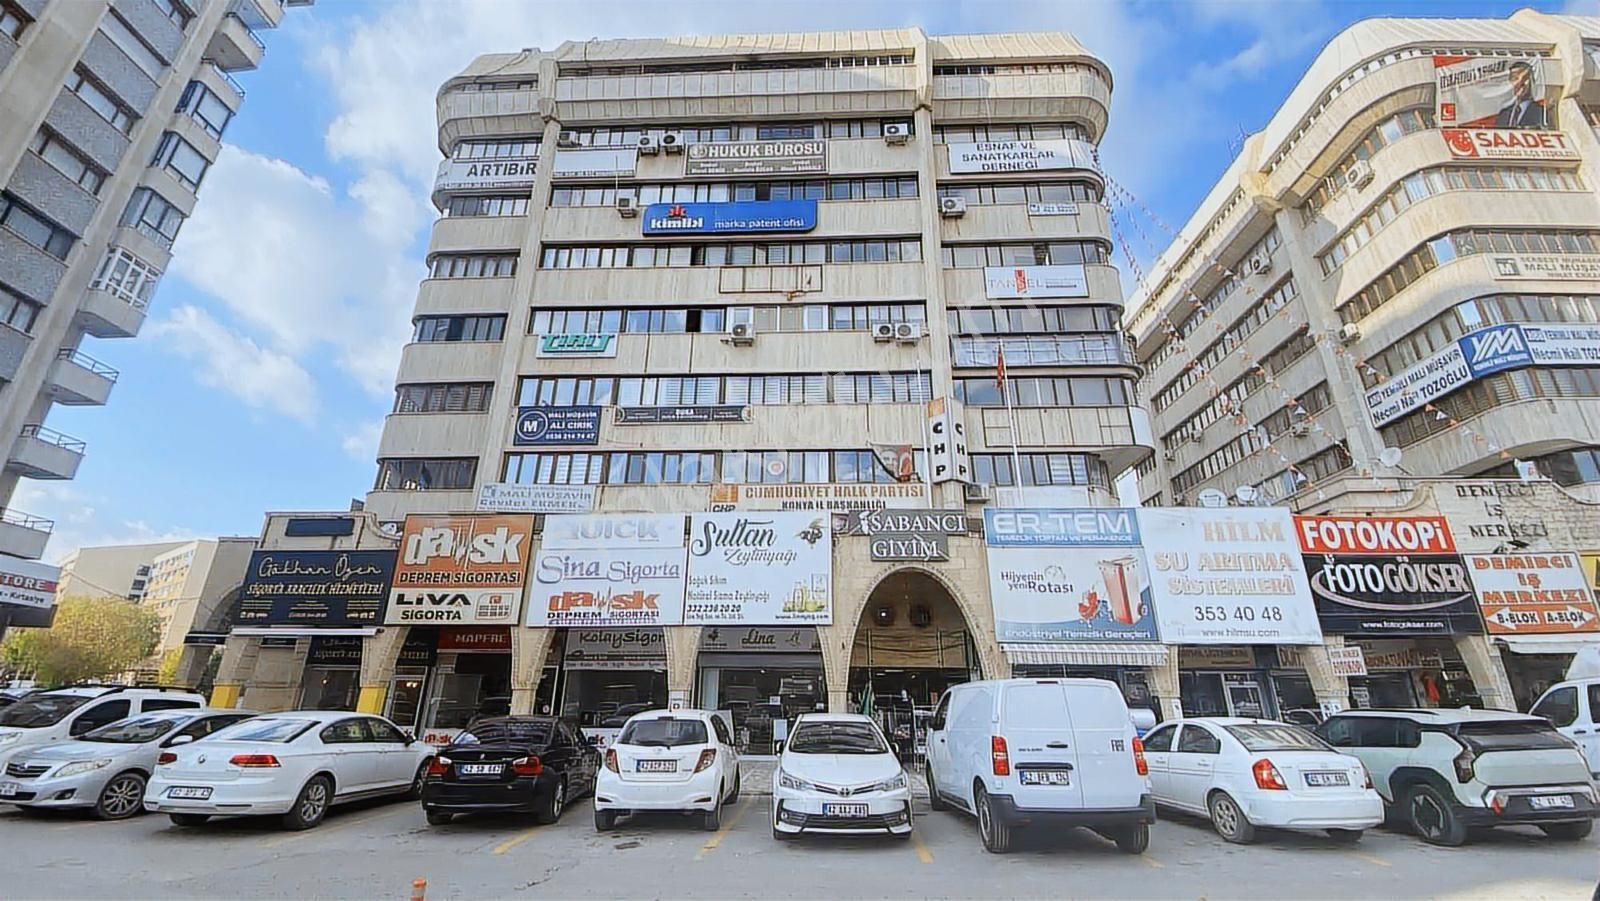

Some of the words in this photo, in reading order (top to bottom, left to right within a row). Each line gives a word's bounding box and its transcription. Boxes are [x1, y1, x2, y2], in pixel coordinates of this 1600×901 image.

[708, 144, 761, 158] HUKUK
[764, 140, 824, 156] BÜROSU
[976, 143, 1019, 151] ESNAF
[1020, 142, 1037, 150] VE
[1475, 132, 1566, 149] SAADET
[962, 151, 1056, 162] SANATKARLAR
[714, 218, 746, 229] marka
[749, 218, 782, 230] patent
[1420, 364, 1468, 398] TOZOĞLU
[549, 421, 566, 429] ALİ
[932, 421, 947, 477] CHP
[955, 421, 968, 477] CHP
[745, 486, 832, 499] CUMHURİYET
[834, 485, 868, 498] HALK
[870, 484, 925, 498] PARTİSİ
[712, 504, 736, 512] CHP
[870, 514, 966, 532] SABANCI
[992, 512, 1132, 535] ER-TEM
[690, 517, 778, 557] Sultan
[872, 536, 940, 558] GİYİM
[536, 555, 601, 584] Sina
[606, 560, 681, 584] Sigorta
[1154, 551, 1190, 571] SU
[1198, 552, 1299, 572] ARITMA
[1472, 555, 1573, 570] DEMİRCİ
[0, 573, 46, 590] TORE
[400, 572, 450, 583] DEPREM
[453, 571, 521, 583] SİGORTASI
[1000, 571, 1044, 584] Hijyenin
[1323, 563, 1385, 593] FOTO
[1383, 556, 1472, 593] GÖKSER
[1028, 581, 1074, 593] Rotası
[1167, 575, 1296, 596] SİSTEMLERİ
[1482, 589, 1588, 604] MERKEZİ
[400, 609, 462, 621] SİGORTA
[1194, 606, 1227, 621] 353
[1233, 606, 1255, 621] 40
[1261, 606, 1283, 621] 48
[455, 633, 509, 644] MAPFRE
[579, 629, 664, 649] KolaySigor
[741, 628, 776, 645] Lina
